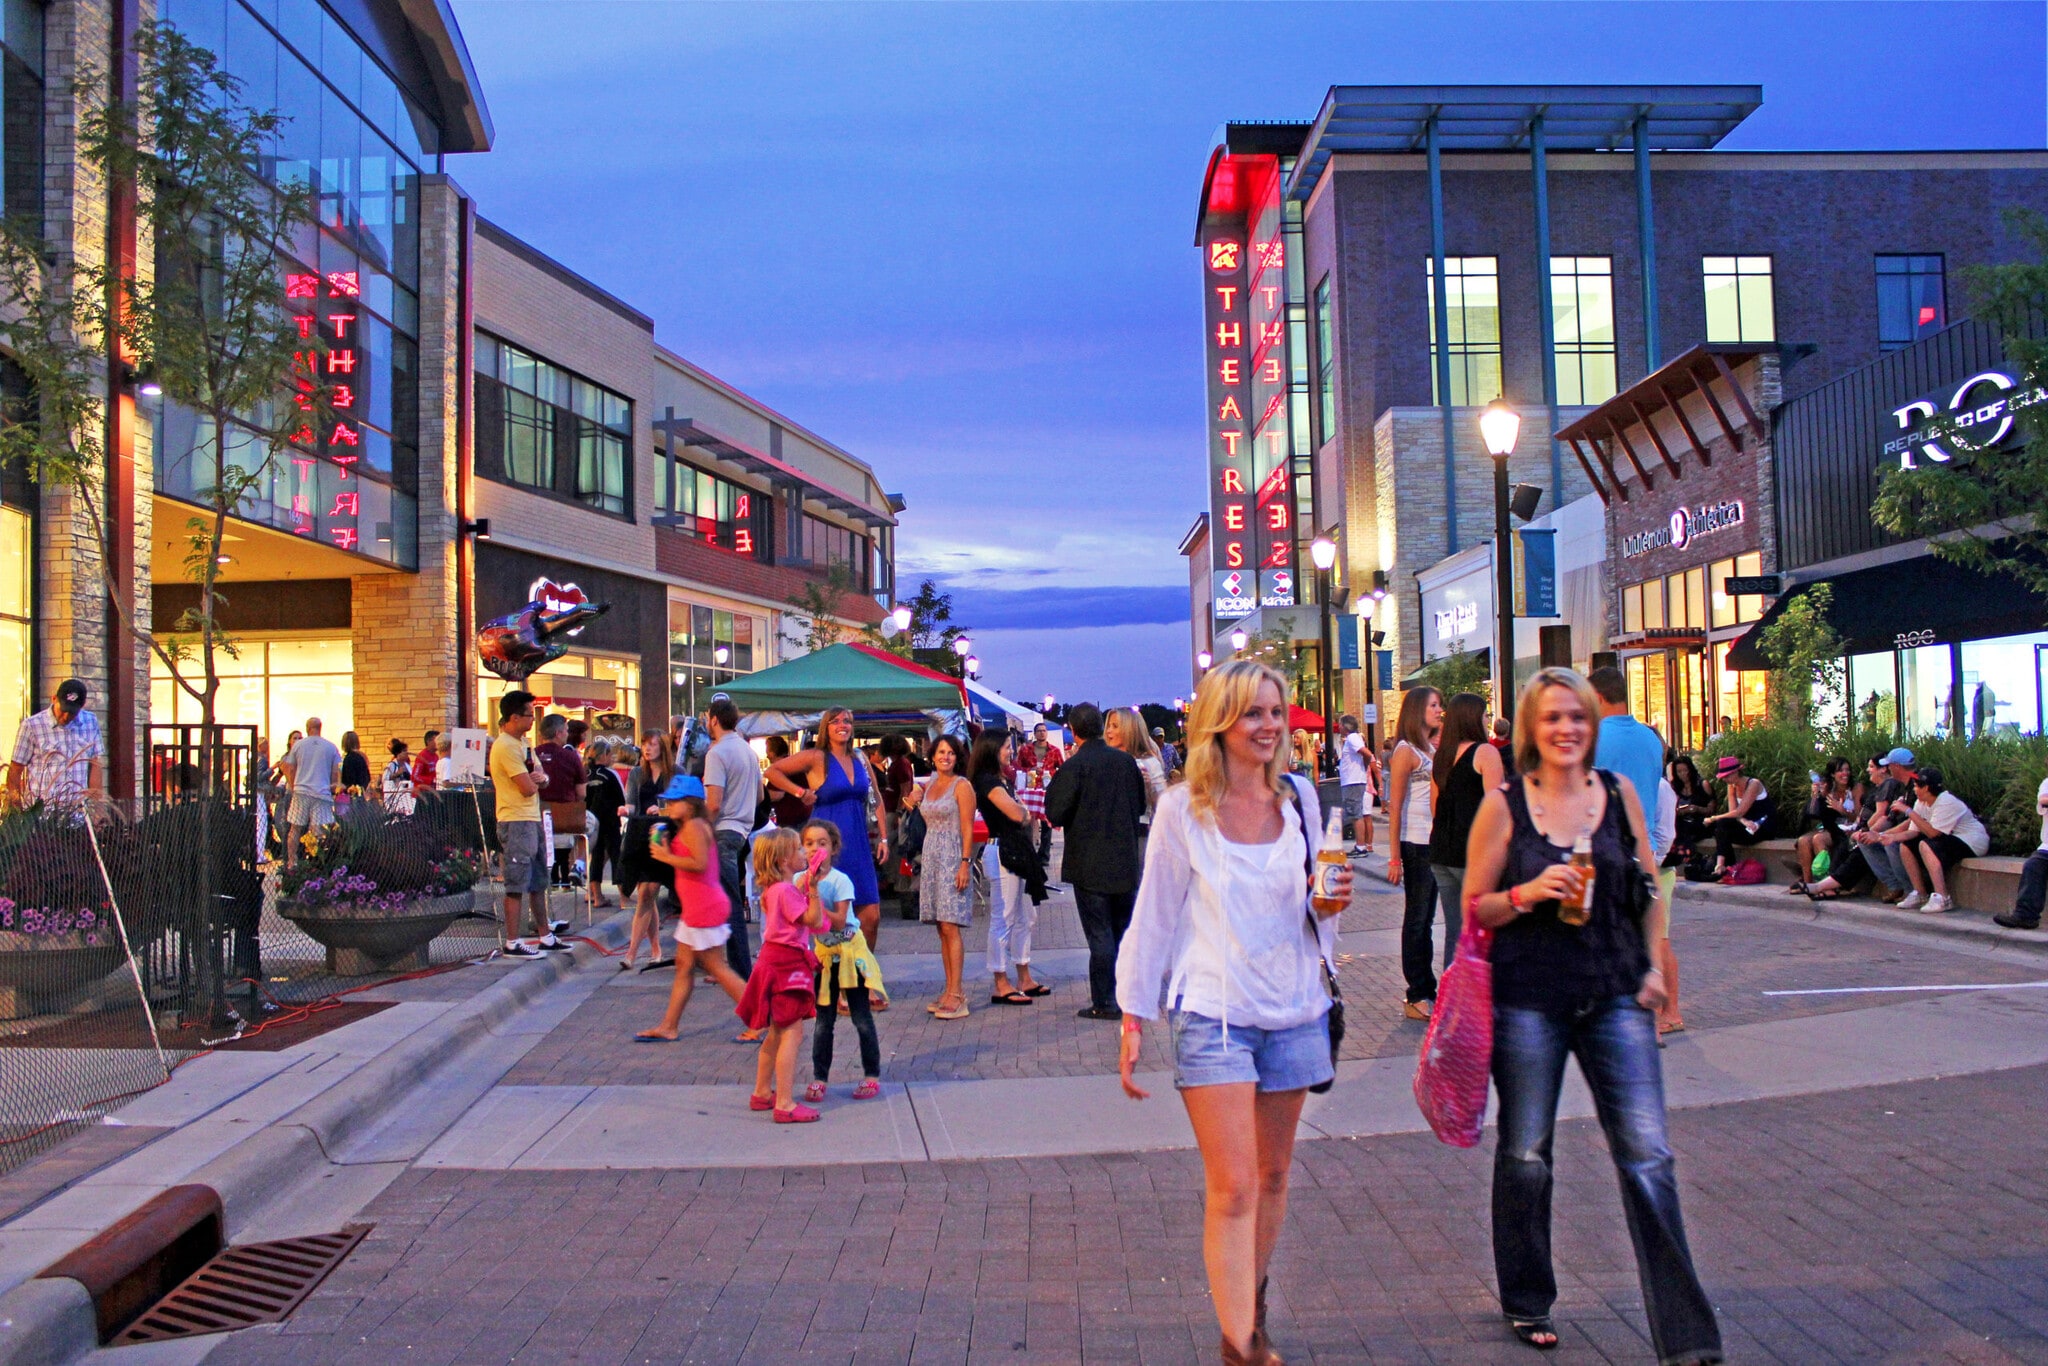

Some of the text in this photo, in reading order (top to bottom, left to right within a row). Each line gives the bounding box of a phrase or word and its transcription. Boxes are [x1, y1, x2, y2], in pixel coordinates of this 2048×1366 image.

[1976, 399, 2006, 423] OF
[1216, 285, 1245, 569] THEATRES
[1215, 597, 1256, 611] ICON
